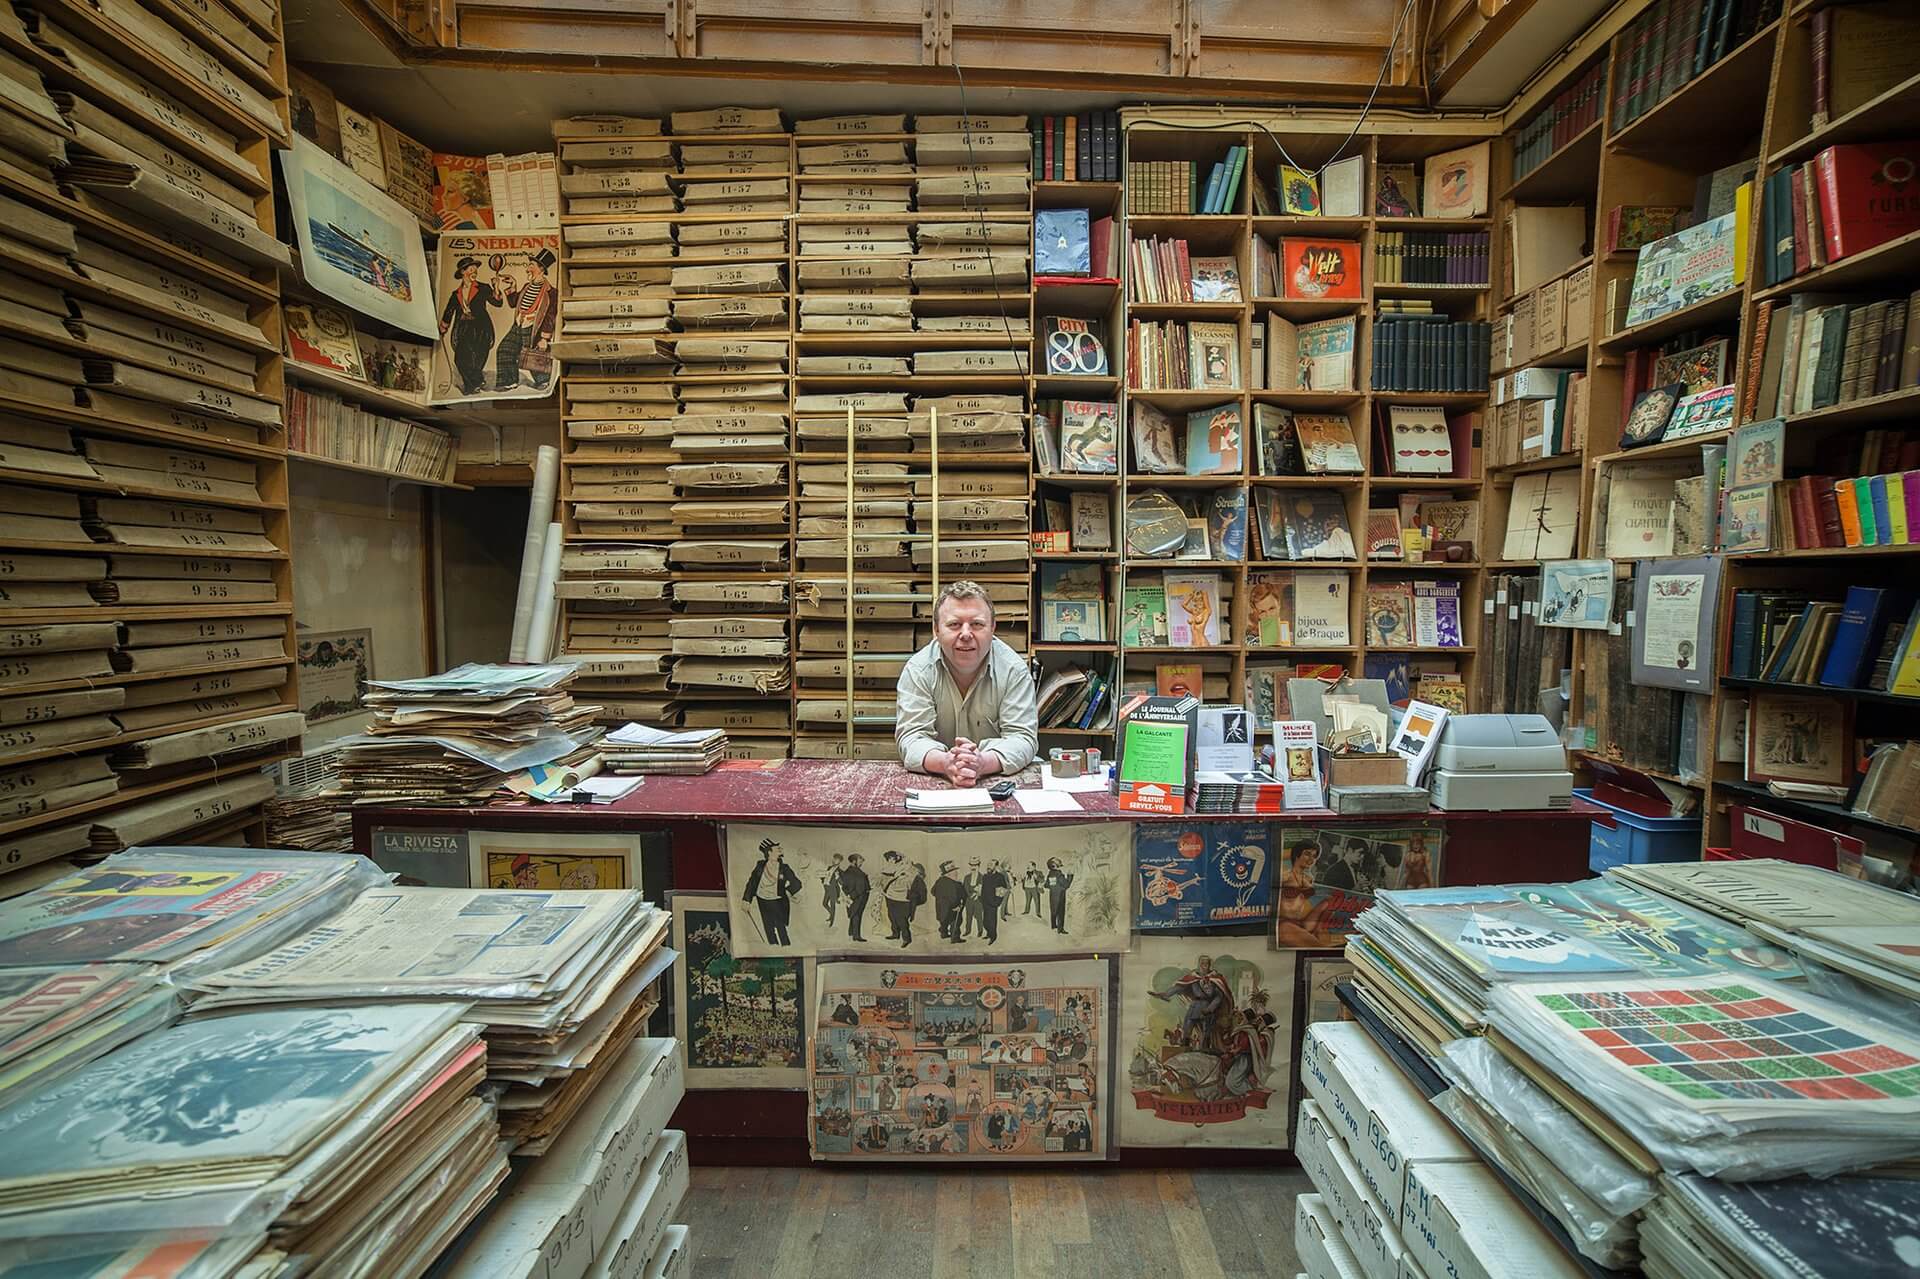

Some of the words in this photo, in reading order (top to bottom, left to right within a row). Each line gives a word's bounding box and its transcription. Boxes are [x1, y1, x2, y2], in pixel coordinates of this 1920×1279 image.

[443, 155, 486, 169] STOP
[449, 239, 475, 250] LES
[1059, 319, 1088, 332] CITY
[1049, 331, 1108, 373] 80
[1297, 616, 1329, 628] bijoux
[1297, 630, 1309, 638] de
[1310, 629, 1345, 641] Braque
[1149, 705, 1177, 714] JOURNAL
[384, 836, 399, 847] LA
[404, 836, 458, 849] RIVISTA
[1367, 1115, 1398, 1174] 1960
